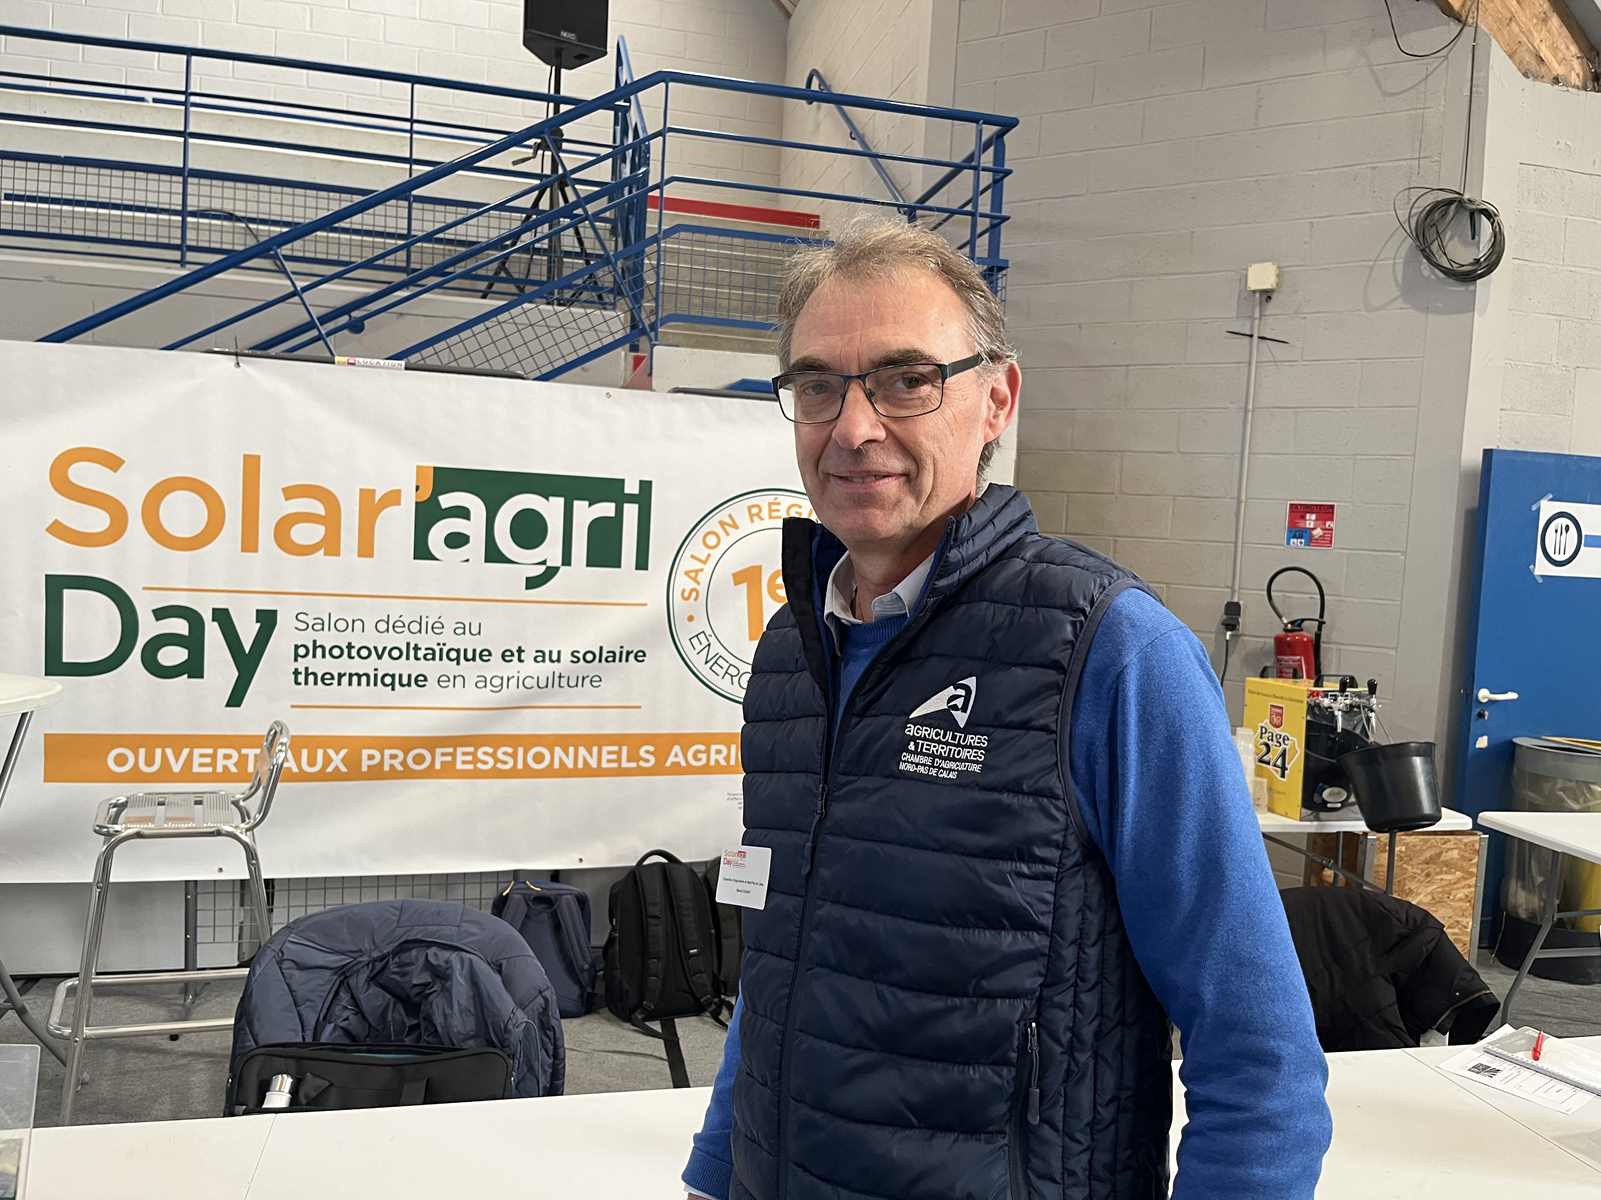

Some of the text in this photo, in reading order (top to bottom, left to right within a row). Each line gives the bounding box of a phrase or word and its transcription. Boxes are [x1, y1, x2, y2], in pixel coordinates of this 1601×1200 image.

[681, 496, 814, 602] SALON RÉG
[294, 611, 483, 637] Salon dédié au
[44, 573, 278, 708] Day
[293, 639, 648, 666] photovoltaïque et au solaire
[292, 666, 603, 694] thermique en agriculture
[1259, 725, 1290, 747] Page
[106, 743, 742, 773] OUVERT AUX PROFESSIONNELS AGRI
[901, 752, 983, 774] CHAMBRE D'AGRICULTURE
[908, 739, 986, 762] & TERRITOIRES
[1257, 741, 1289, 779] 24
[898, 761, 929, 775] NORD-PAS
[937, 769, 958, 779] CALAIS
